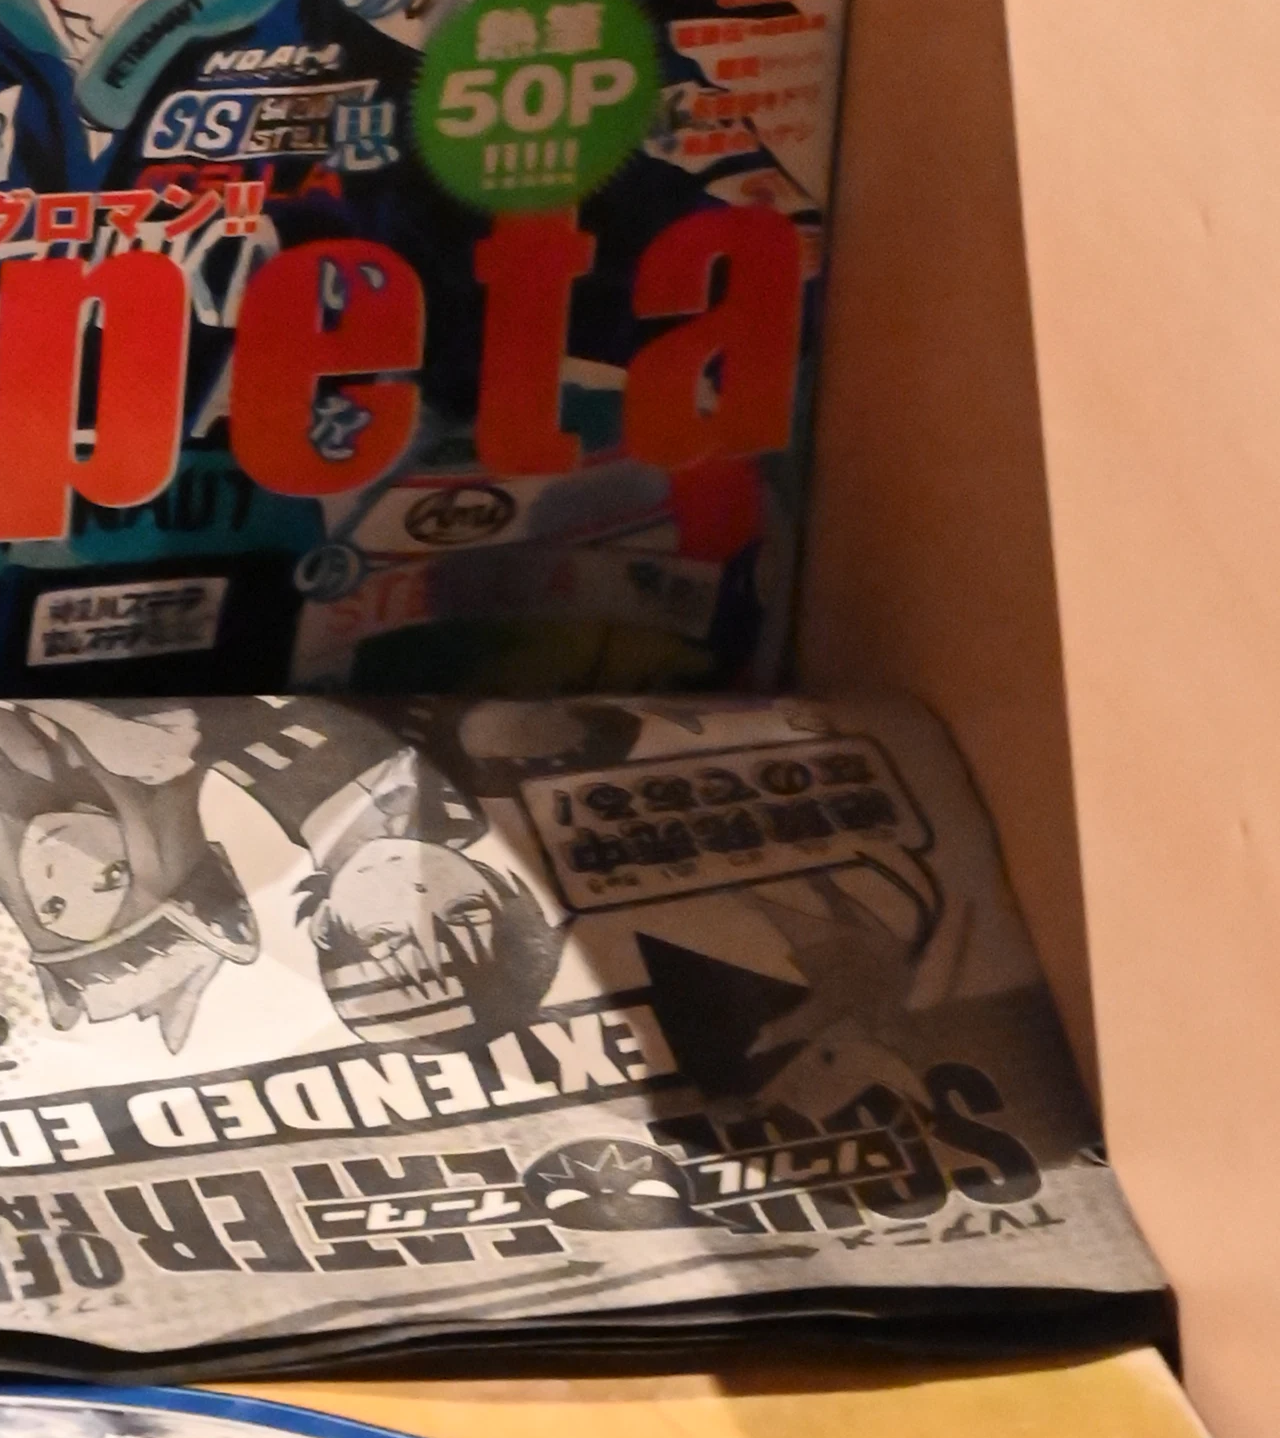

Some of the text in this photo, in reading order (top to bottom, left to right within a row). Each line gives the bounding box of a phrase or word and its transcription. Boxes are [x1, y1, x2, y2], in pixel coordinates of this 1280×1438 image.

[434, 56, 638, 140] 50P
[130, 1010, 652, 1151] EXTENDED
[317, 1194, 524, 1236] イーター
[834, 1201, 1068, 1252] TVアニメ
